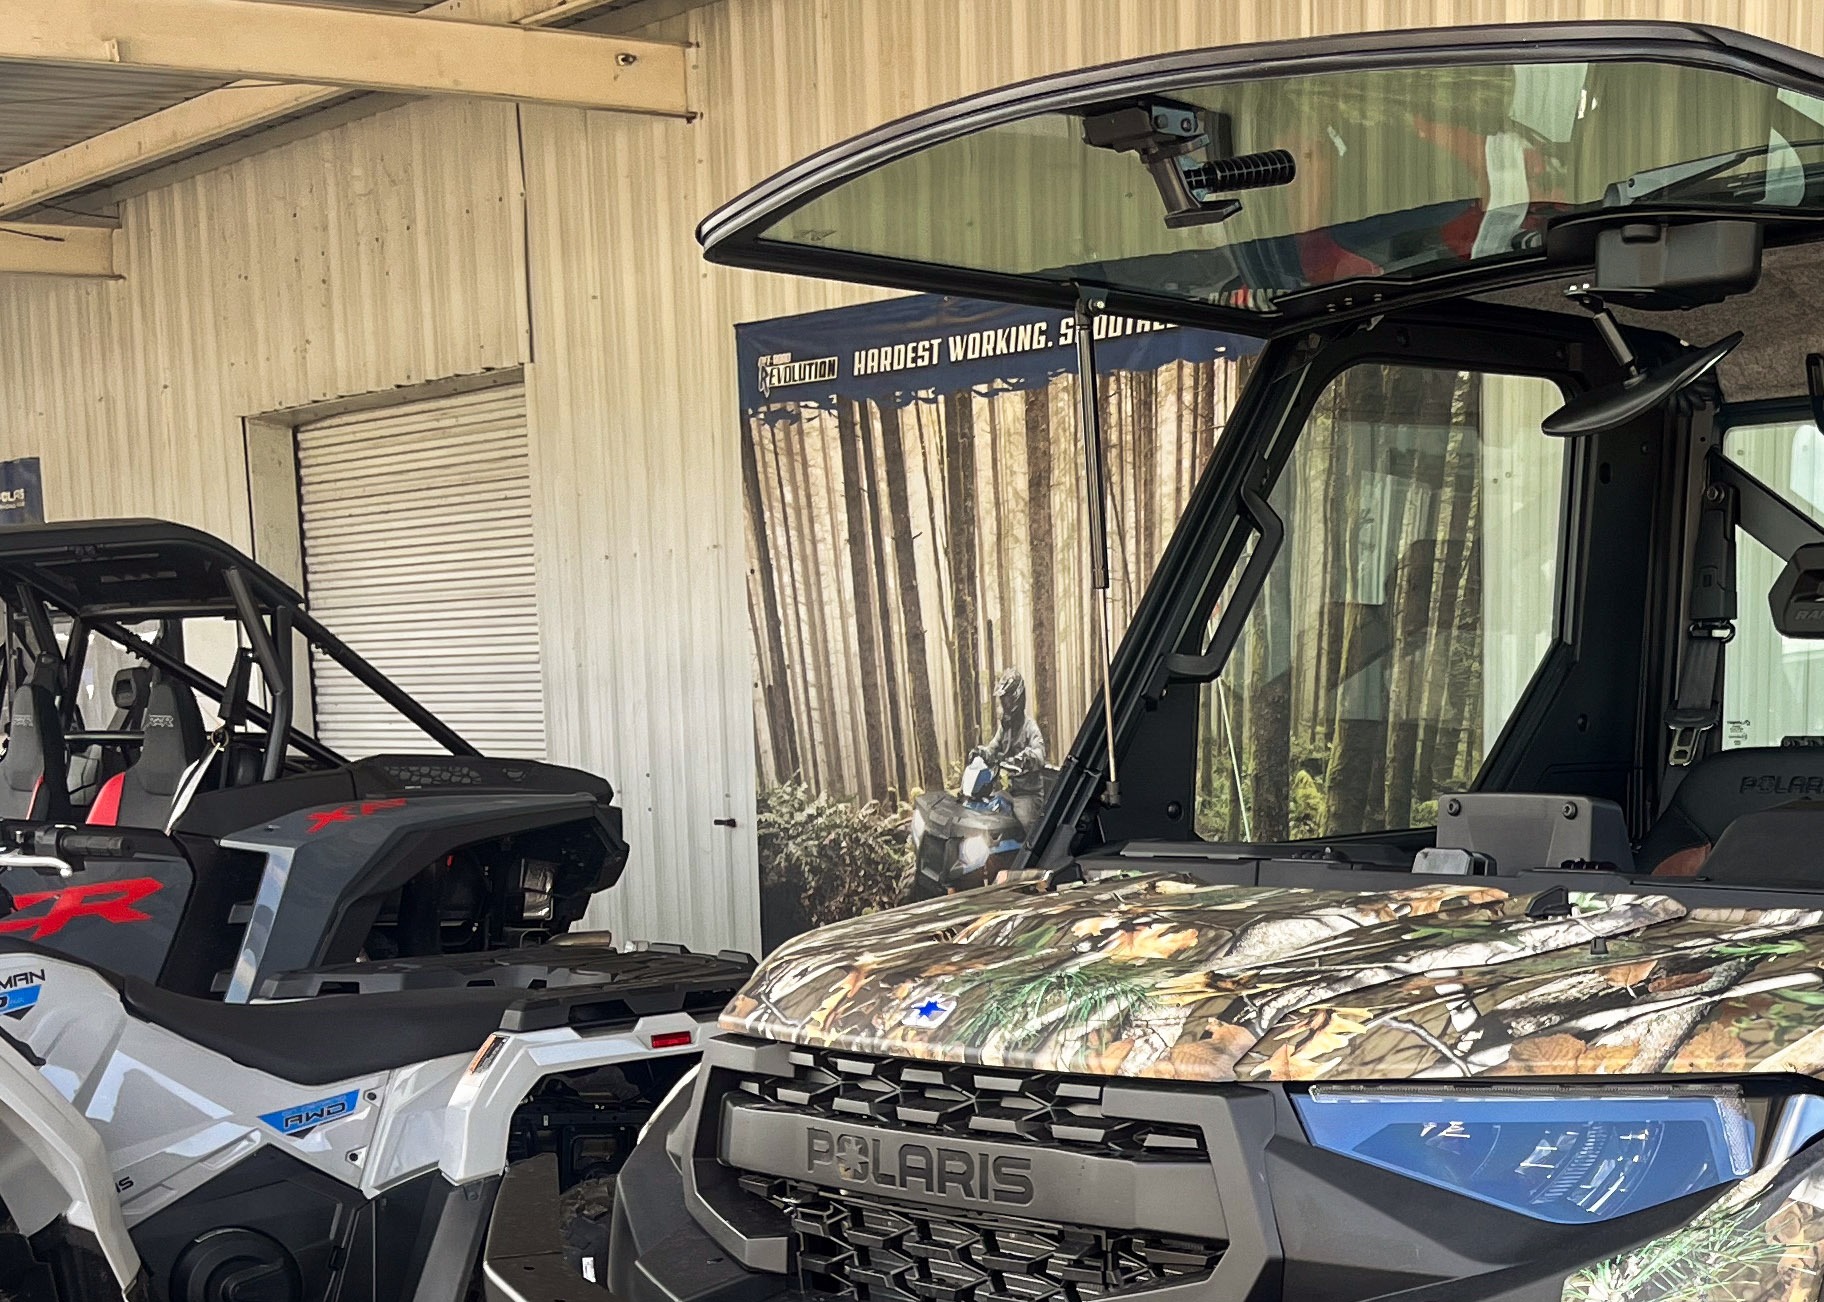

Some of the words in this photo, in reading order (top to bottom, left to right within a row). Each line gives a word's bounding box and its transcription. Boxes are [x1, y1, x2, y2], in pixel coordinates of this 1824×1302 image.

[853, 338, 942, 377] HARDEST
[948, 321, 1053, 363] WORKING.
[759, 357, 838, 398] REVOLUTION
[283, 1102, 346, 1128] AWD
[807, 1127, 1035, 1207] POLARIS
